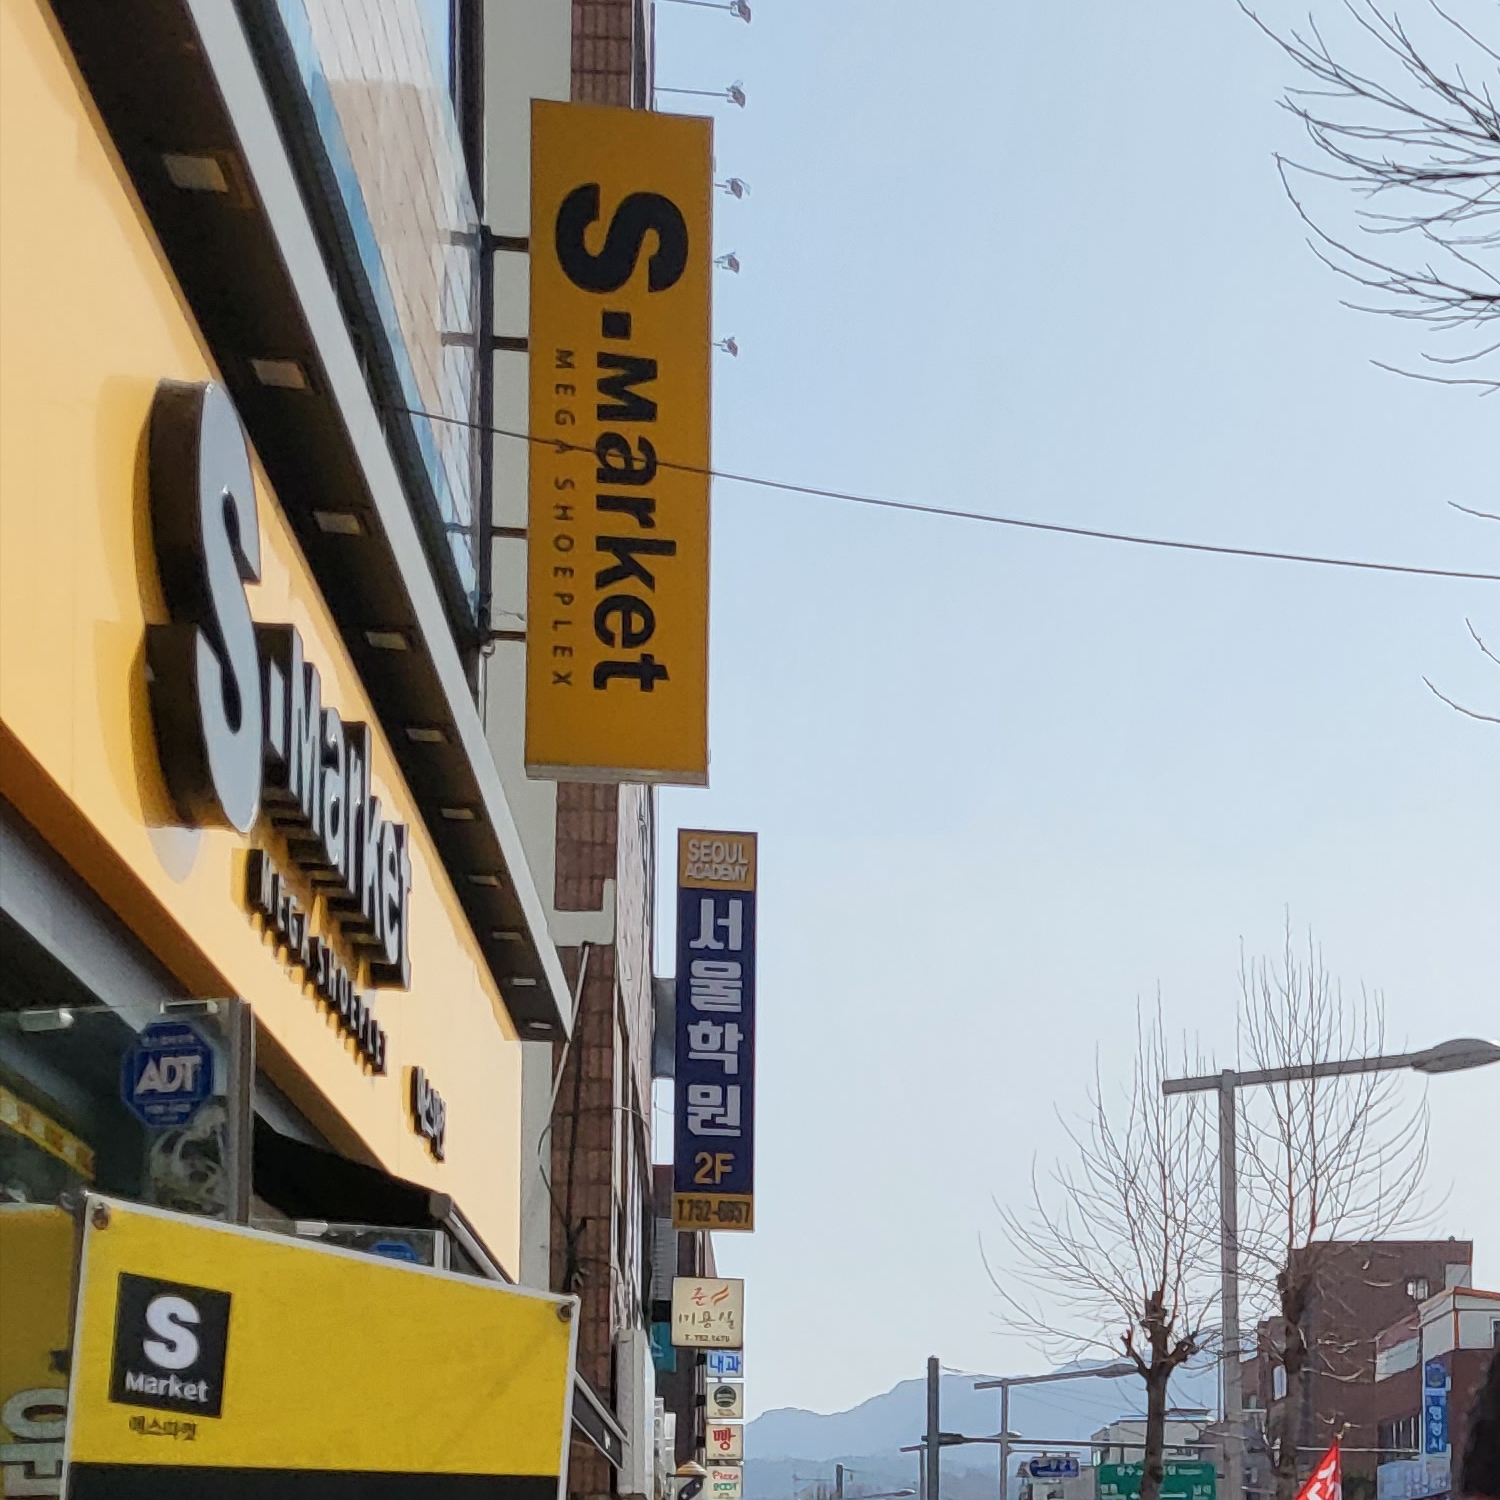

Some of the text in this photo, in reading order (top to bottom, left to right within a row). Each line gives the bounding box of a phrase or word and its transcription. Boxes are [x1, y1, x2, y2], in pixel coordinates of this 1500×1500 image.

[550, 347, 577, 689] MEGA SHOEPLEX
[687, 838, 749, 864] SEOUL
[685, 861, 749, 882] ACADEMY
[686, 898, 744, 1138] 서울학원
[134, 1055, 202, 1096] ADT
[693, 1151, 735, 1186] 2F
[143, 1296, 201, 1371] S
[709, 1354, 742, 1374] 내과
[125, 1371, 210, 1403] Market
